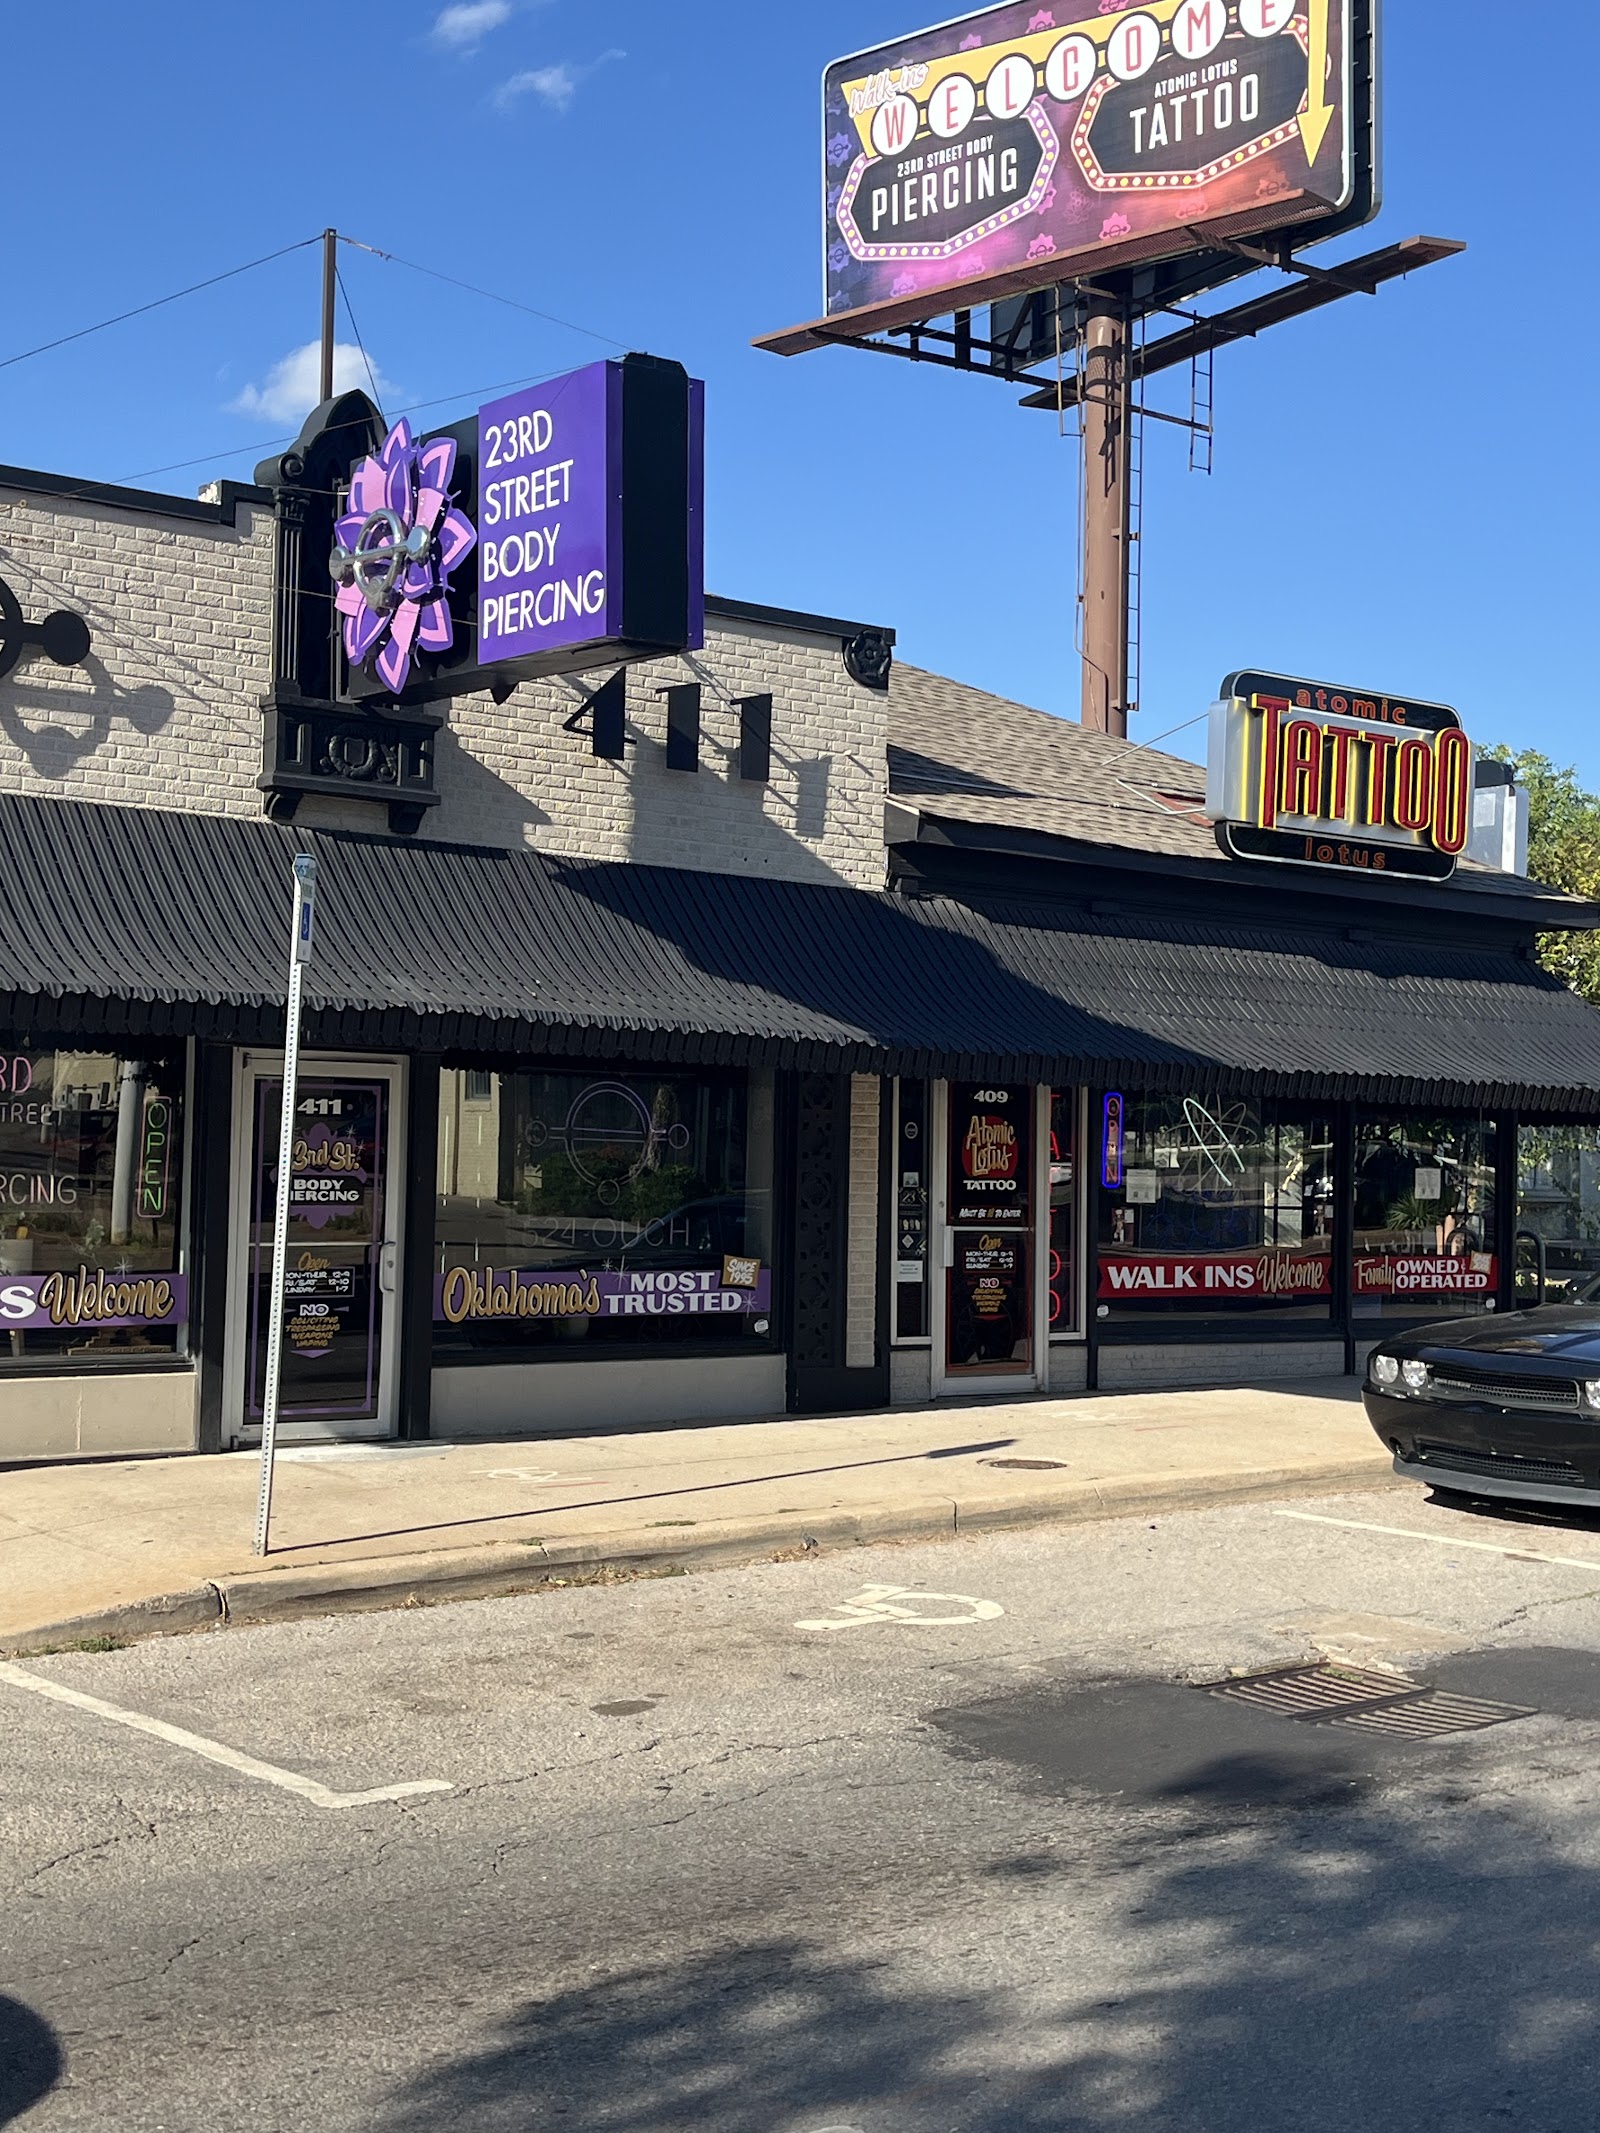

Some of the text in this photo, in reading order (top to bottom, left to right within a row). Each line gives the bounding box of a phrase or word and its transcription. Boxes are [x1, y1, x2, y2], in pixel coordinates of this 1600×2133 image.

[884, 0, 1276, 149] WELCOME
[1154, 58, 1238, 99] ATOMIC LOTUS
[1129, 73, 1259, 154] TATTOO
[897, 135, 993, 178] 23RD STREET BODY
[872, 147, 1018, 232] PIERCING
[484, 409, 553, 469] 23RD
[484, 459, 574, 526] STREET
[483, 523, 560, 583] BODY
[482, 569, 605, 639] PIERCING
[1296, 688, 1407, 725] atomic
[1252, 693, 1470, 855] TATTOO
[1305, 837, 1386, 869] lotus
[297, 1098, 342, 1115] 411
[974, 1090, 1008, 1103] 409
[966, 1115, 1016, 1148] Atomic
[143, 1101, 168, 1212] OPEN
[292, 1139, 330, 1171] 3rd
[972, 1144, 1013, 1176] Lotus
[290, 1190, 360, 1202] IERCING
[293, 1178, 345, 1191] BODY
[963, 1179, 1016, 1191] TATTOO
[297, 1251, 332, 1271] Open
[727, 1258, 757, 1273] SINCE
[1107, 1251, 1324, 1293] WALK INS Welcome
[1354, 1255, 1395, 1294] Family
[1396, 1259, 1459, 1275] OWNED
[40, 1264, 174, 1325] Welcome
[284, 1286, 317, 1294] UNDAY
[285, 1278, 318, 1287] RI/SAT
[442, 1267, 601, 1323] Oklahoma's
[630, 1271, 716, 1293] MOST
[979, 1277, 1000, 1289] NO
[1396, 1273, 1487, 1289] OPERATED
[0, 1285, 37, 1319] S
[299, 1303, 329, 1317] NO
[604, 1291, 742, 1314] TRUSTED
